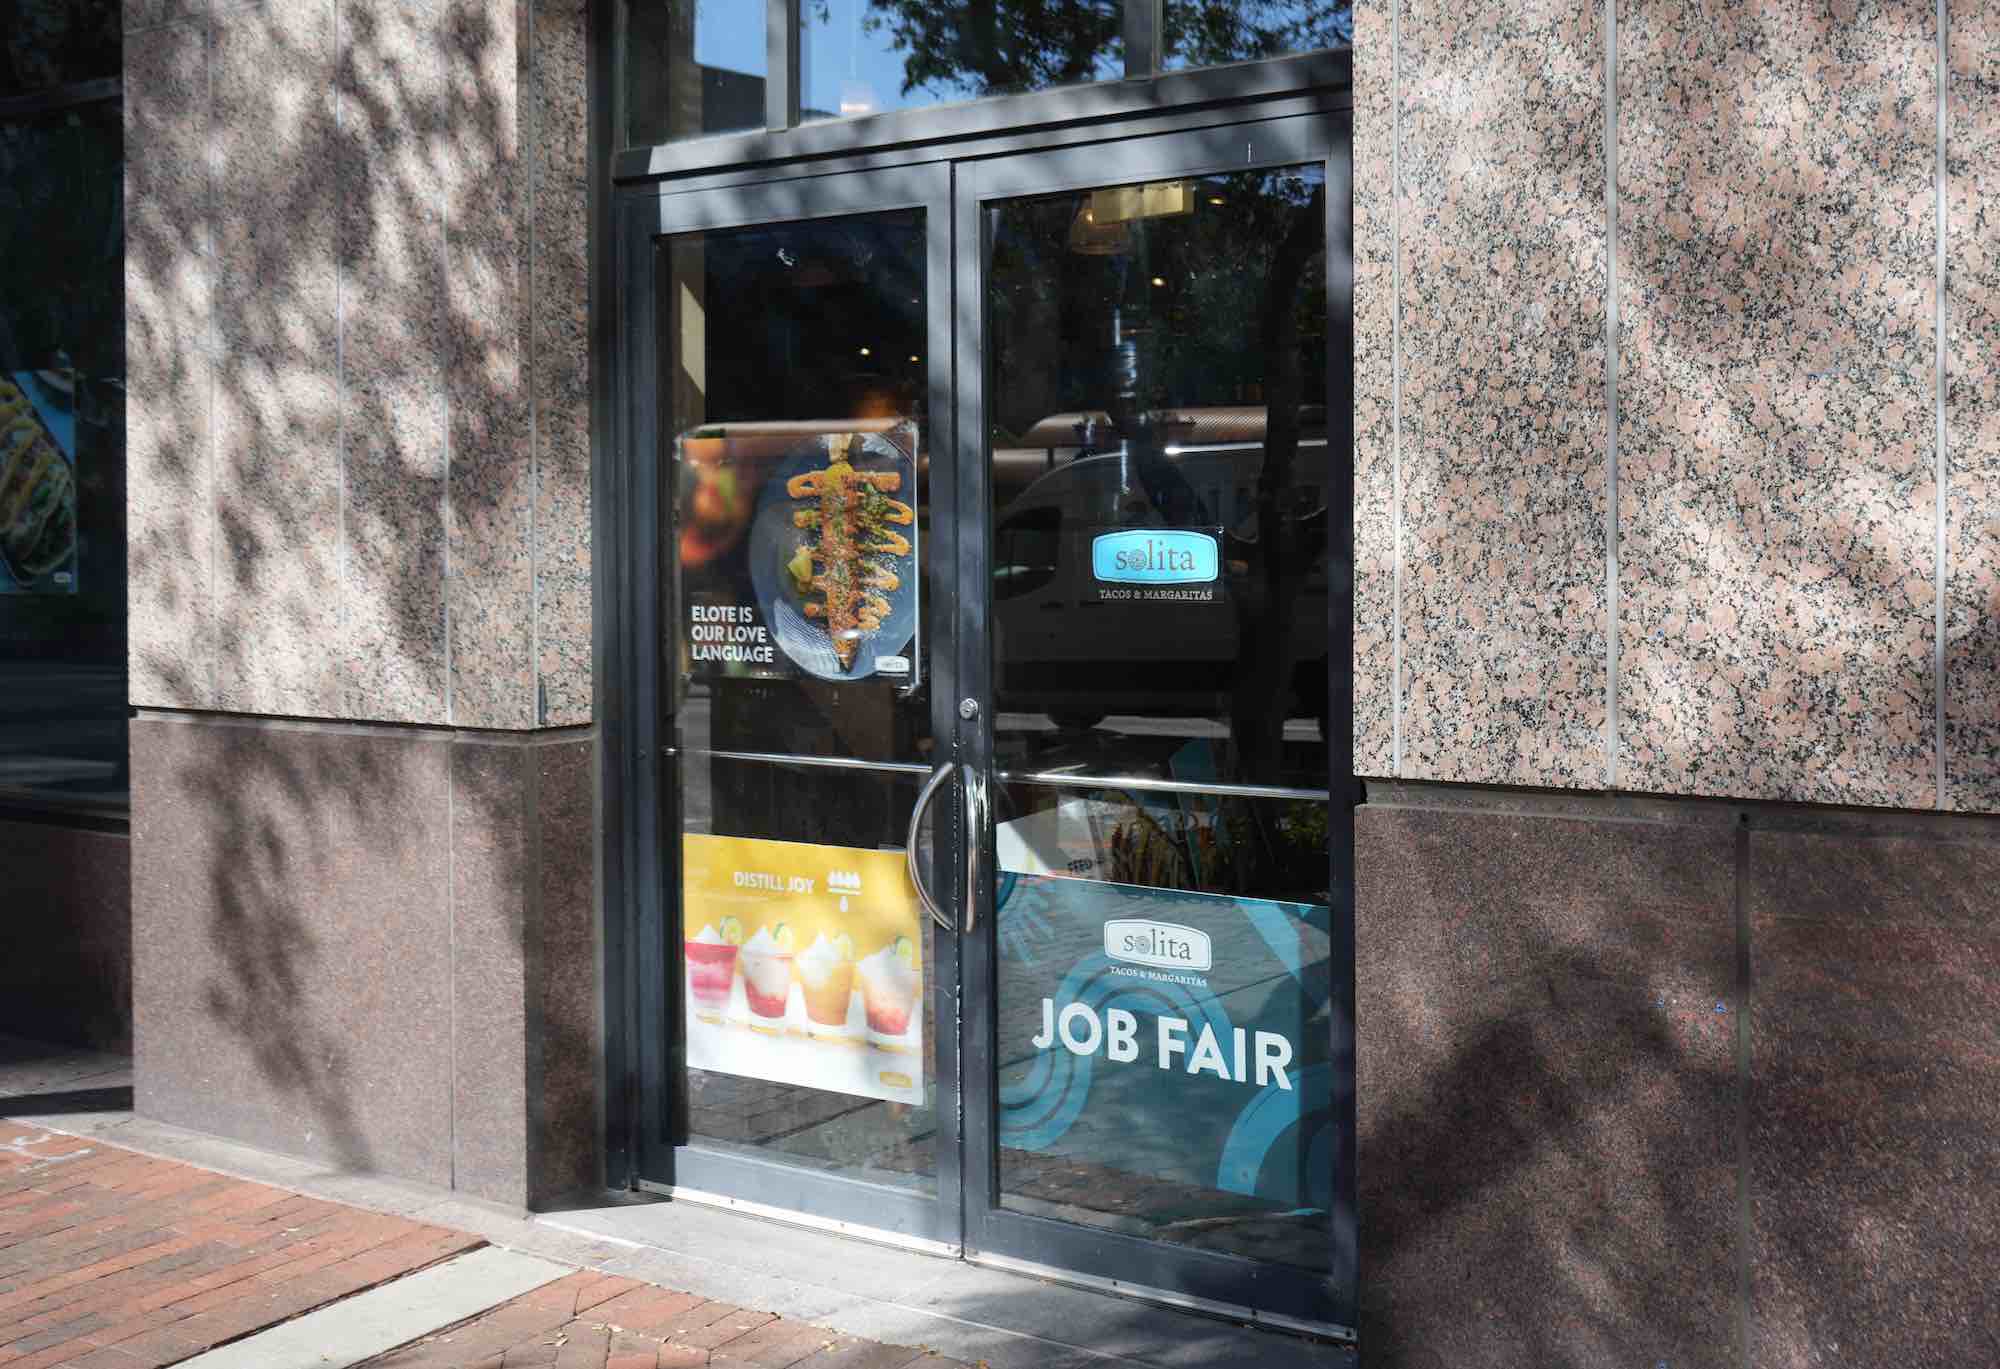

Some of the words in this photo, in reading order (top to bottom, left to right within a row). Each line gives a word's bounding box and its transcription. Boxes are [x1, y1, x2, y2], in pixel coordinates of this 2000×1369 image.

[1115, 539, 1196, 571] solita
[1099, 589, 1132, 600] TACOS
[1133, 590, 1142, 600] &
[1144, 589, 1213, 601] MARGARITAS
[692, 606, 736, 622] ELOTE
[739, 606, 753, 623] IS
[691, 625, 725, 641] OUR
[728, 625, 767, 643] LOVE
[692, 644, 774, 662] LANGUAGE
[734, 871, 785, 891] DISTILL
[787, 876, 815, 894] JOY
[1123, 928, 1192, 960] solita
[1110, 966, 1138, 977] TACOS
[1149, 972, 1208, 988] MARGARITAS
[1031, 998, 1139, 1063] JOB
[1158, 1016, 1293, 1090] FAIR
